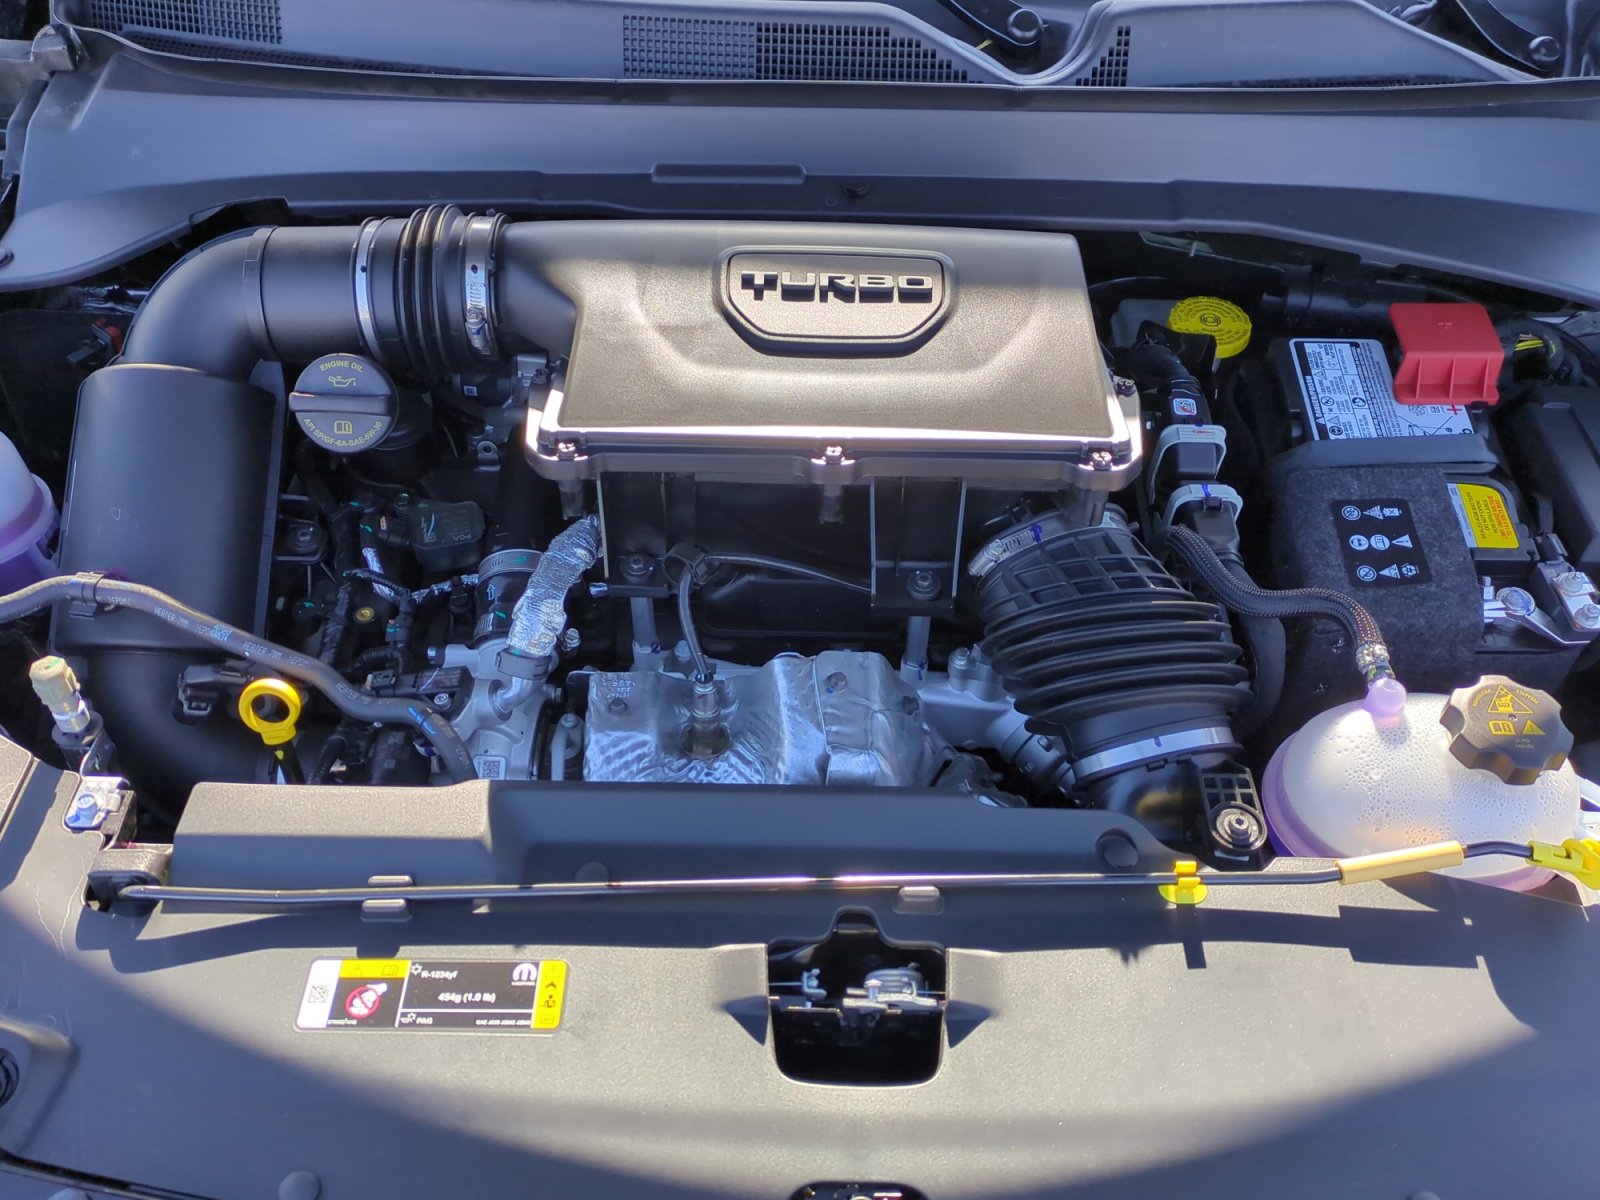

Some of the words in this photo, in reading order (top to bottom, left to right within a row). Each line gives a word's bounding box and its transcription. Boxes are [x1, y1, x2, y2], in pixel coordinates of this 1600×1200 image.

[741, 271, 933, 303] TURBO
[320, 360, 350, 372] ENGINE
[350, 362, 364, 372] OIL
[1305, 376, 1321, 416] DANGER/POISON
[304, 418, 314, 430] API
[154, 606, 176, 622] HEATER
[421, 970, 458, 980] R-1234yf
[438, 992, 462, 1004] 454g
